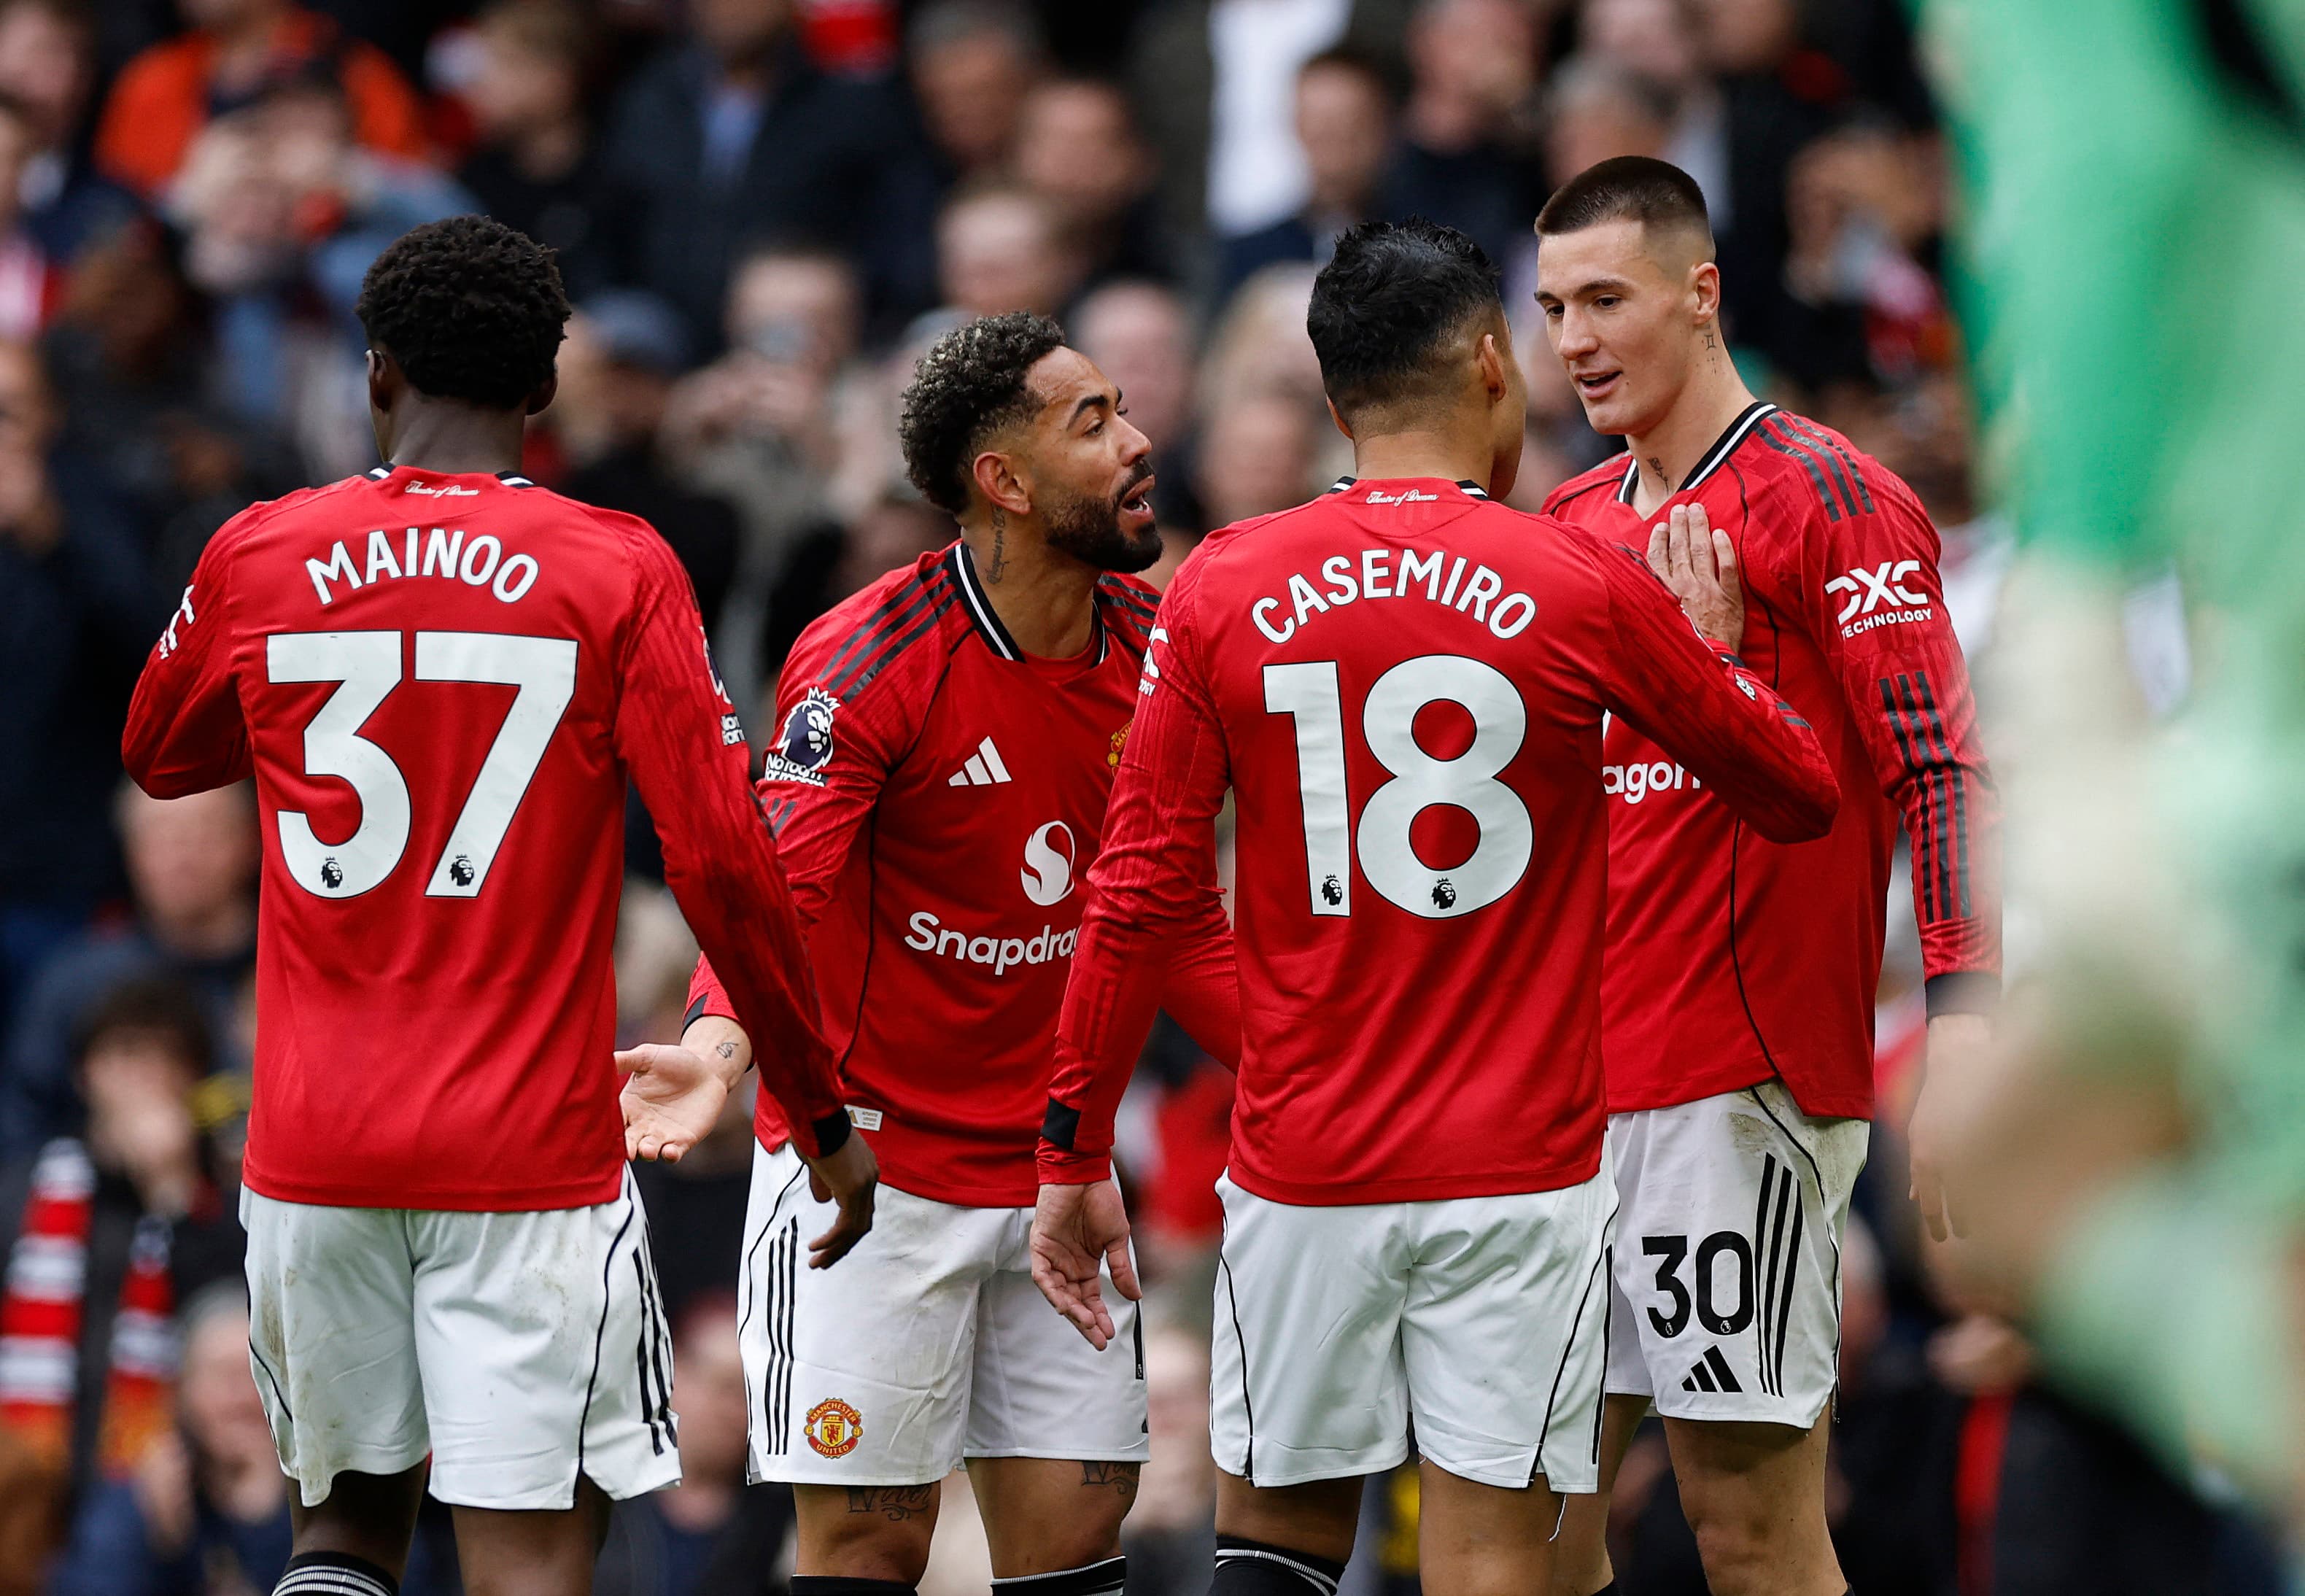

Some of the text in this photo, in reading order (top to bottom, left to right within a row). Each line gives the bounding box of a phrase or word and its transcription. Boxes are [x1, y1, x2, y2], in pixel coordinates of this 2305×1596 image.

[305, 527, 539, 605] MAINOO
[1251, 548, 1537, 645] CASEMIRO
[1824, 559, 1929, 626] DXC
[266, 630, 579, 899] 37
[1261, 654, 1535, 920] 18
[904, 911, 1081, 976] Snapdra
[1642, 1231, 1754, 1339] 30
[810, 1402, 856, 1422] MANCHESTER
[816, 1444, 849, 1454] UNITED
